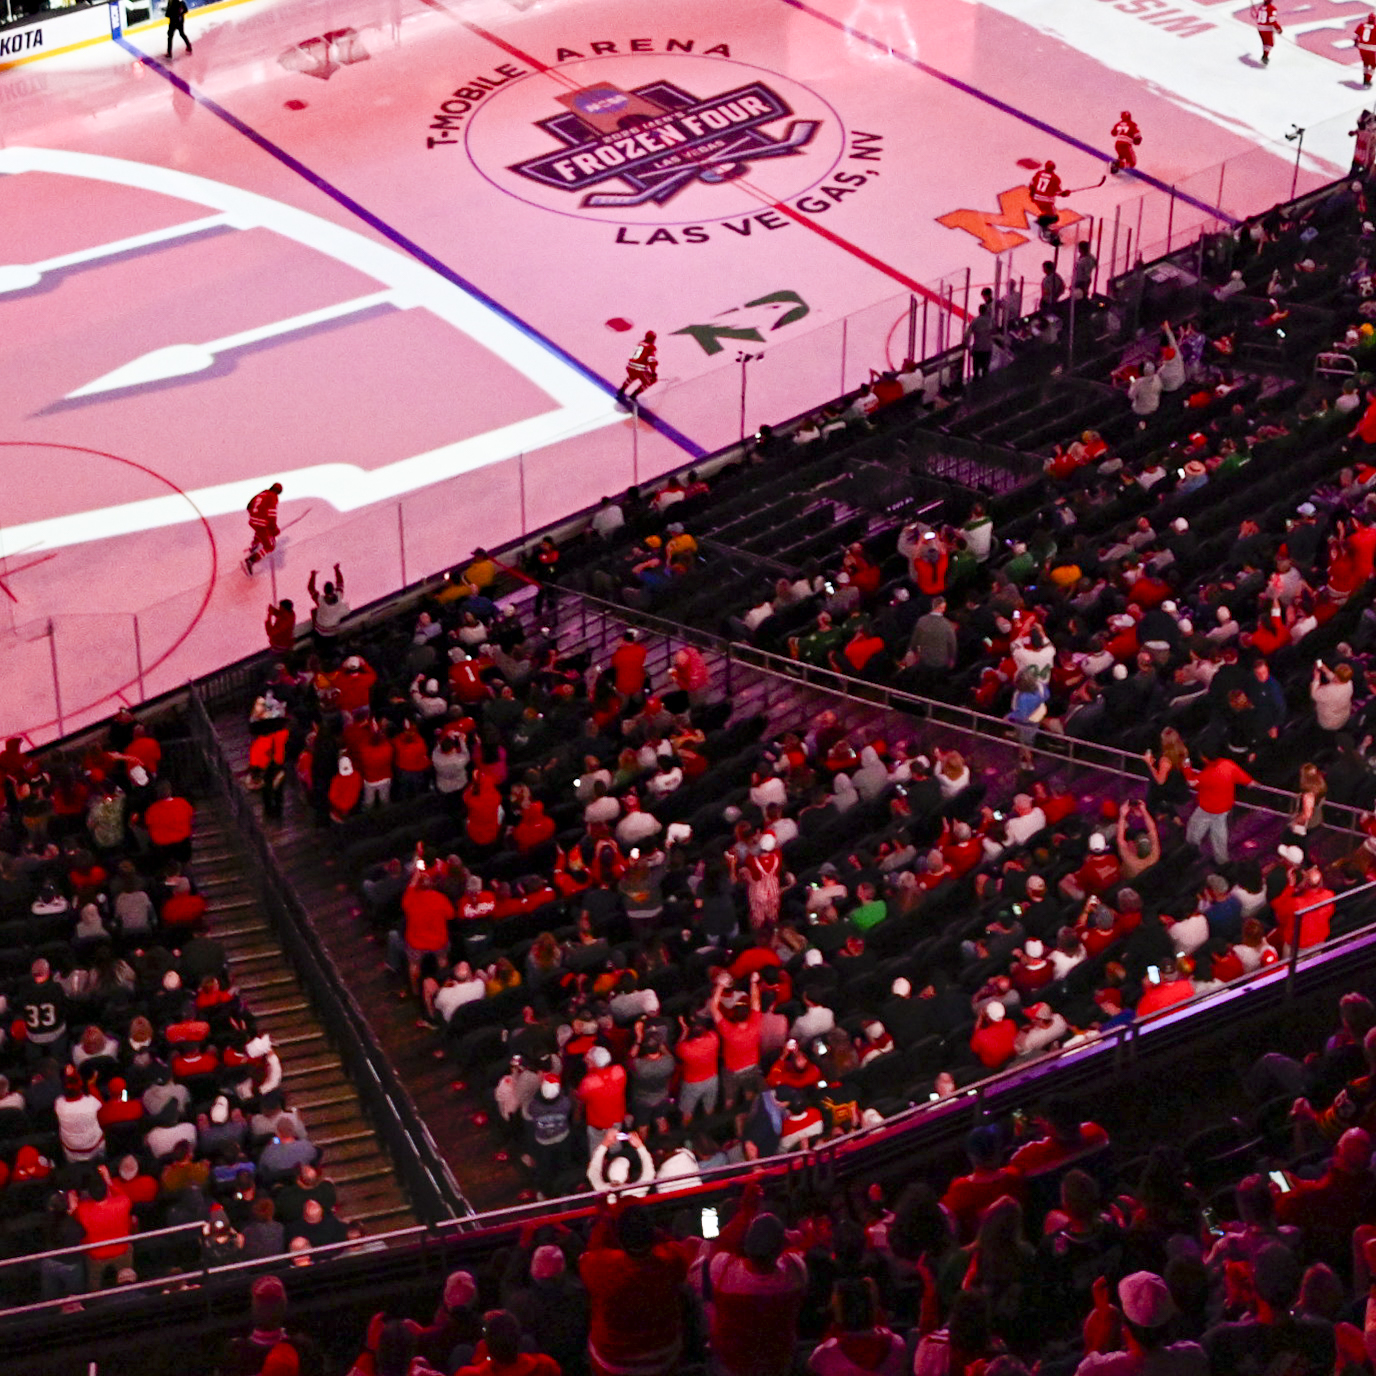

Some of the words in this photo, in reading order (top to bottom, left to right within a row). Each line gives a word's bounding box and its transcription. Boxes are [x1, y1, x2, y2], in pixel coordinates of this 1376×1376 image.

[427, 64, 528, 149] T-MOBILE
[556, 38, 731, 62] ARENA
[552, 124, 687, 182] FROZEN
[681, 95, 772, 143] FOUR
[614, 226, 710, 245] LAS
[849, 130, 884, 161] NV
[25, 1002, 56, 1028] 33
